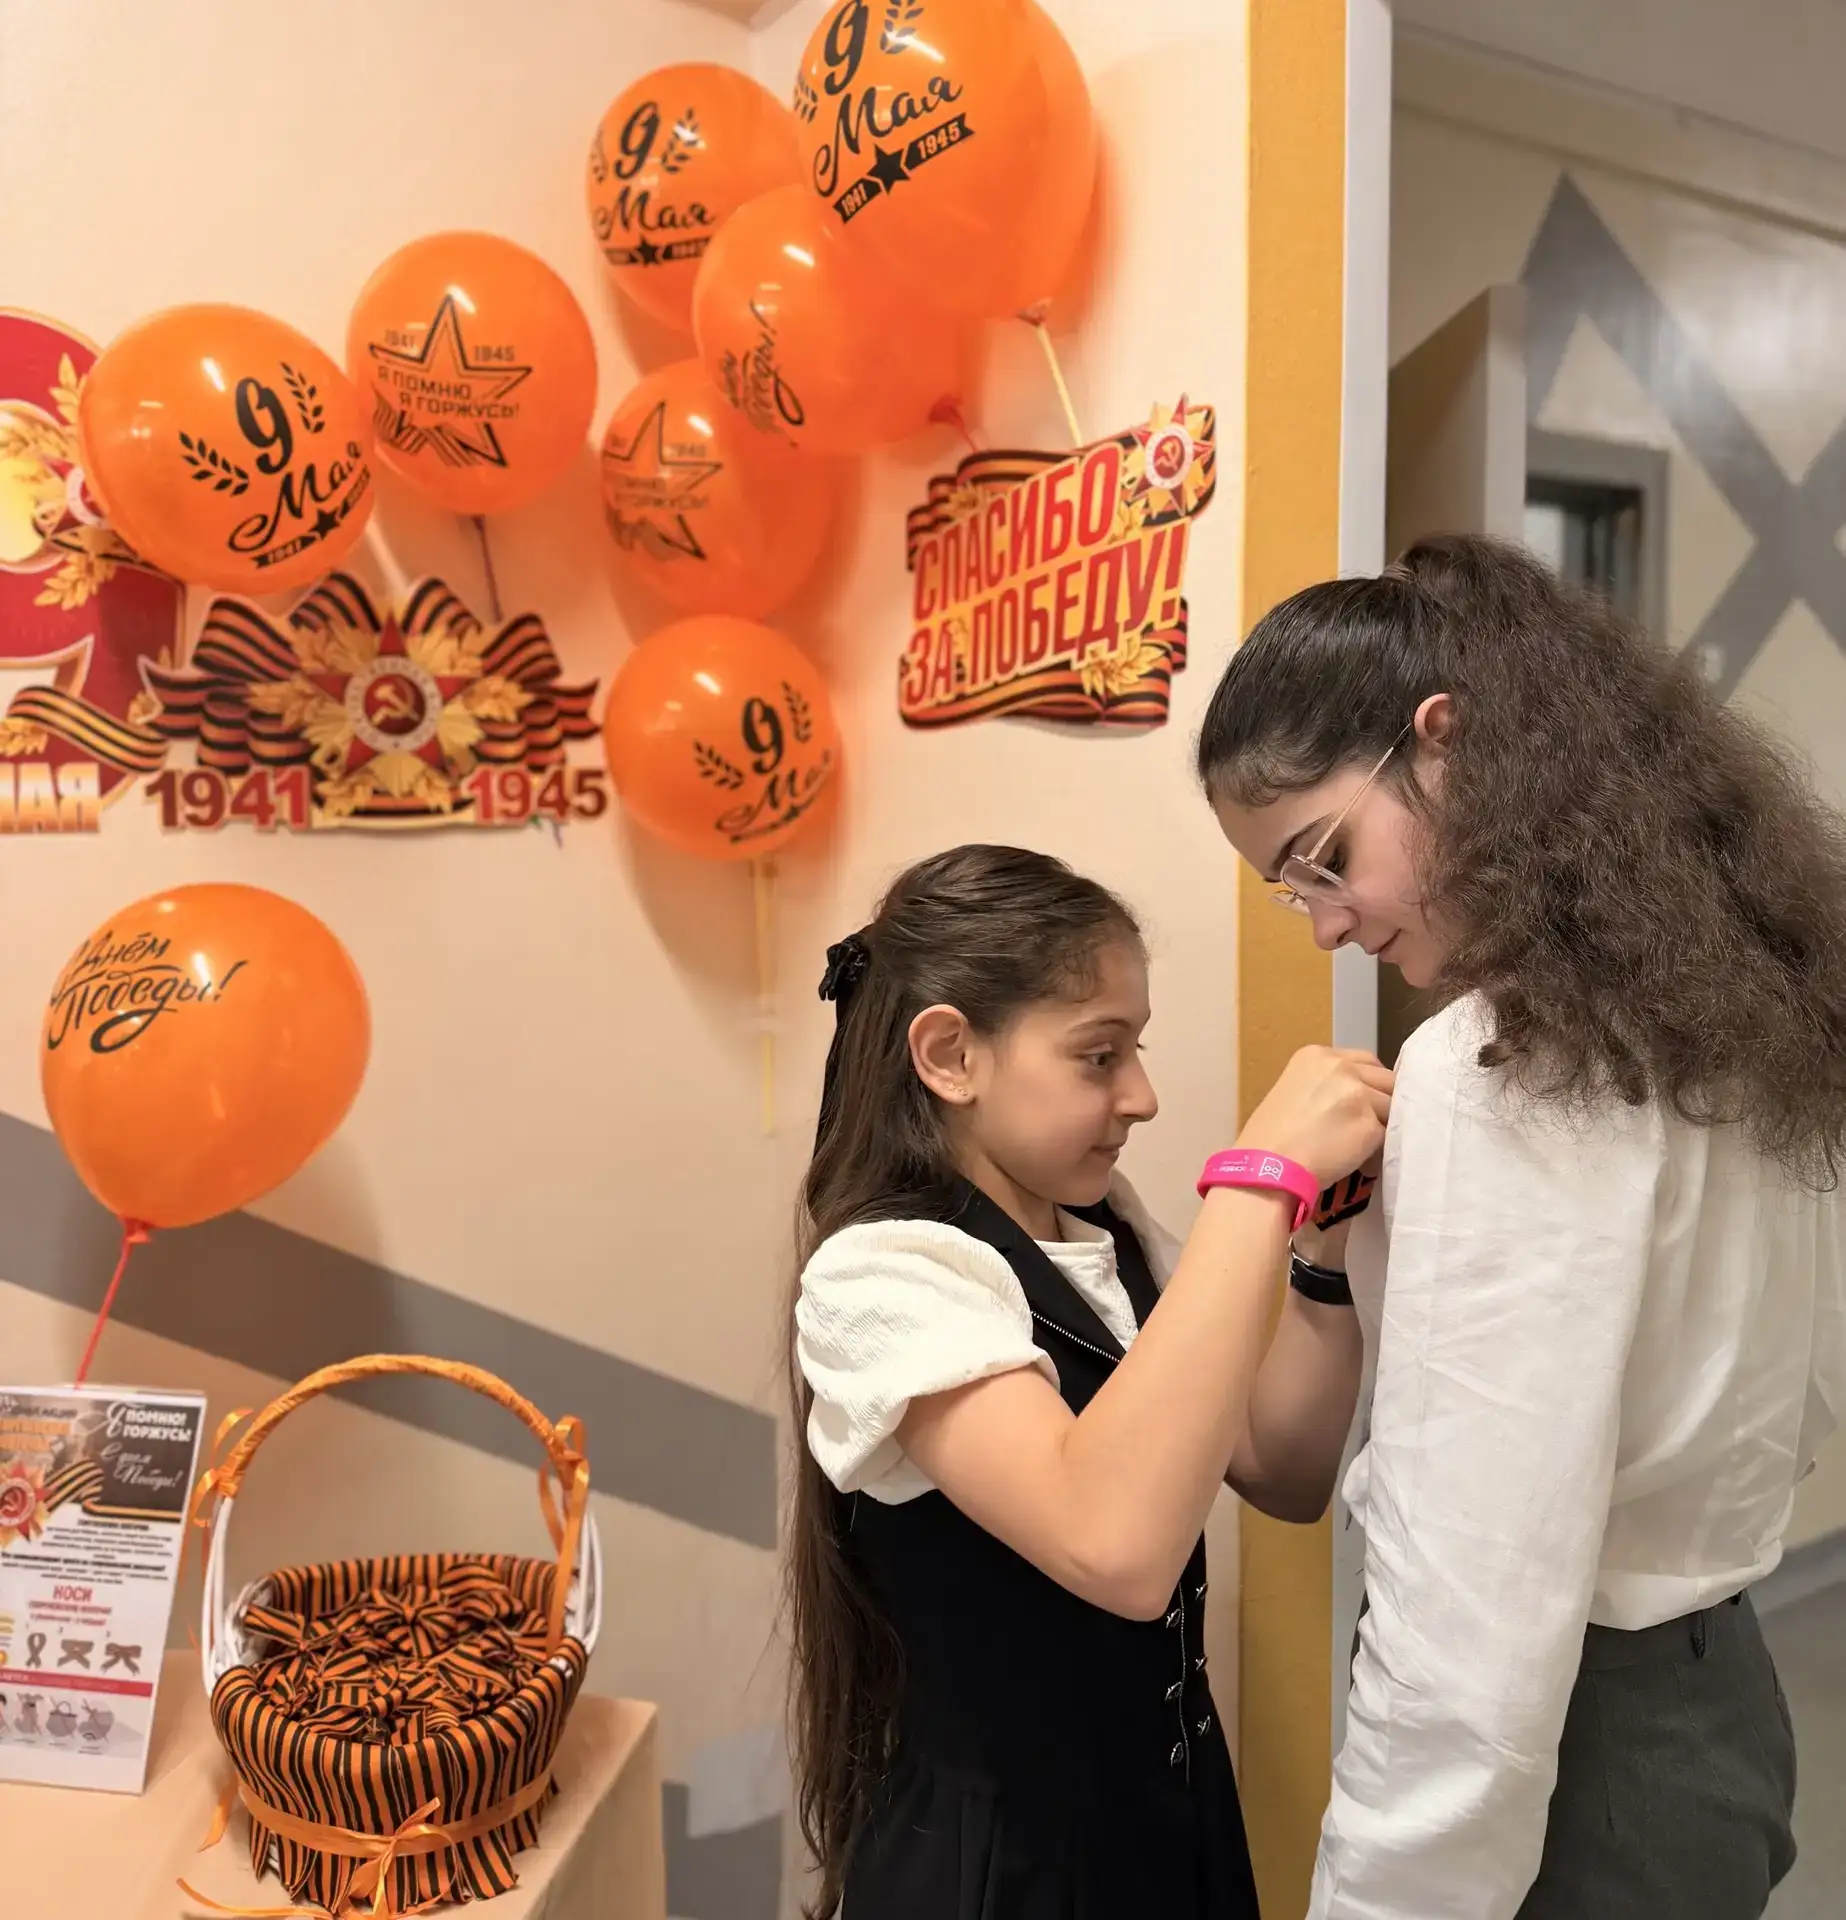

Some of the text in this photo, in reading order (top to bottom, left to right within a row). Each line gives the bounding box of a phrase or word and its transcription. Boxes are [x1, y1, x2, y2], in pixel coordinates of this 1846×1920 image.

[824, 0, 869, 95] 9
[614, 101, 660, 180] 9
[813, 76, 963, 197] Мая
[840, 121, 961, 217] 1941 1945
[595, 186, 716, 240] Мая
[393, 370, 472, 401] ПОМНЮ
[416, 396, 520, 419] ГОРЖУСЬ!
[235, 377, 293, 474] 9
[228, 441, 361, 553] Мая
[914, 445, 1122, 622] СПАСИБО
[905, 523, 1188, 706] ЗА ПОБЕДУ!
[742, 697, 784, 775] 9
[144, 766, 608, 828] 1941 1945
[48, 959, 248, 1053] Победы!
[122, 1424, 192, 1442] ГОРЖУСЬ!
[125, 1408, 188, 1426] ПОМНЮ!
[53, 1585, 94, 1601] НОСИ
